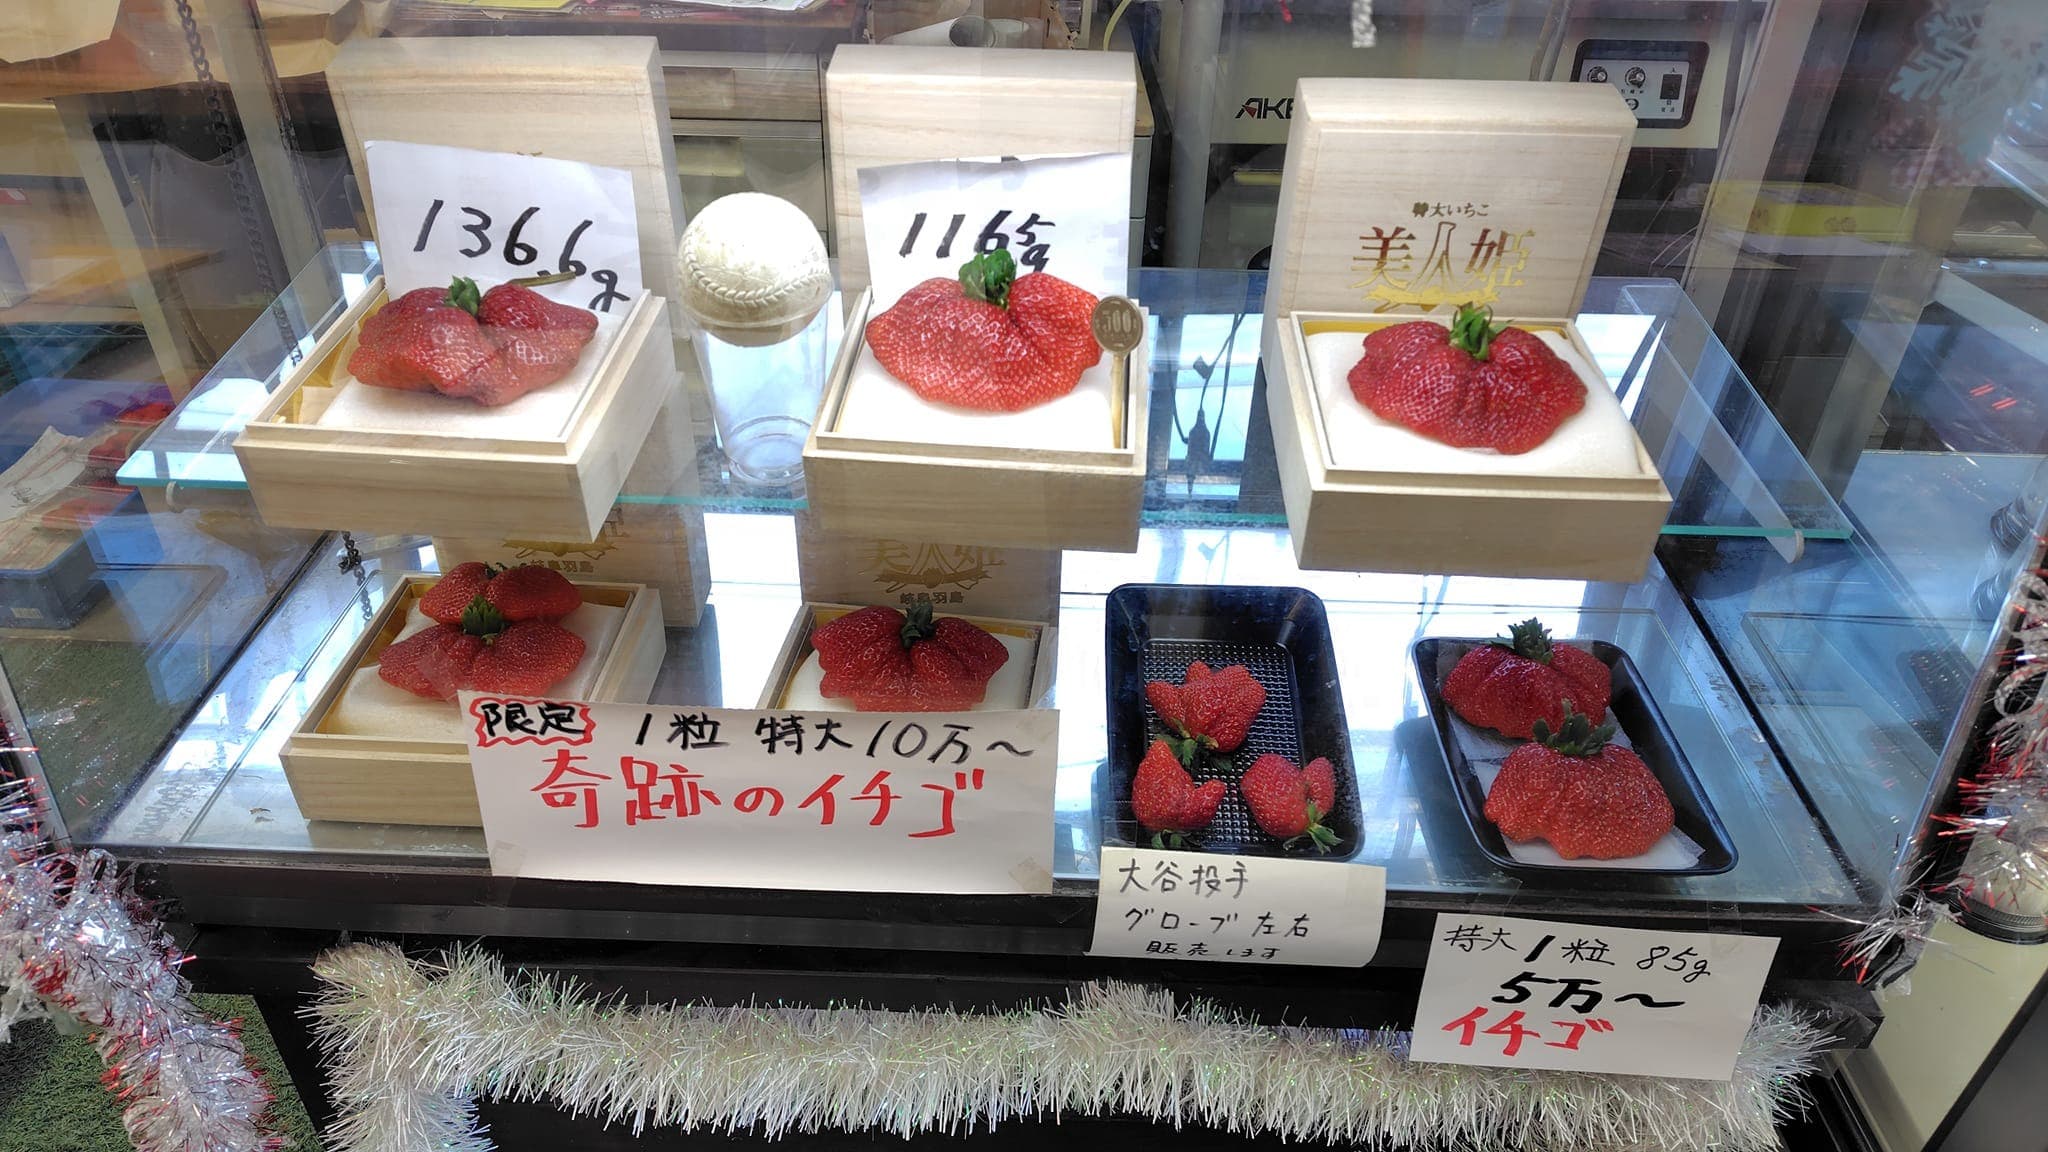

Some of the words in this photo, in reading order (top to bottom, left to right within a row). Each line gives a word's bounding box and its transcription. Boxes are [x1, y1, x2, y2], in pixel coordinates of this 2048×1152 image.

[483, 702, 586, 737] 限定
[530, 748, 986, 839] 奇跡のイチゴ
[1118, 857, 1249, 899] 大谷投手
[1636, 946, 1711, 984] 85g
[1441, 1006, 1615, 1057] イチゴ
